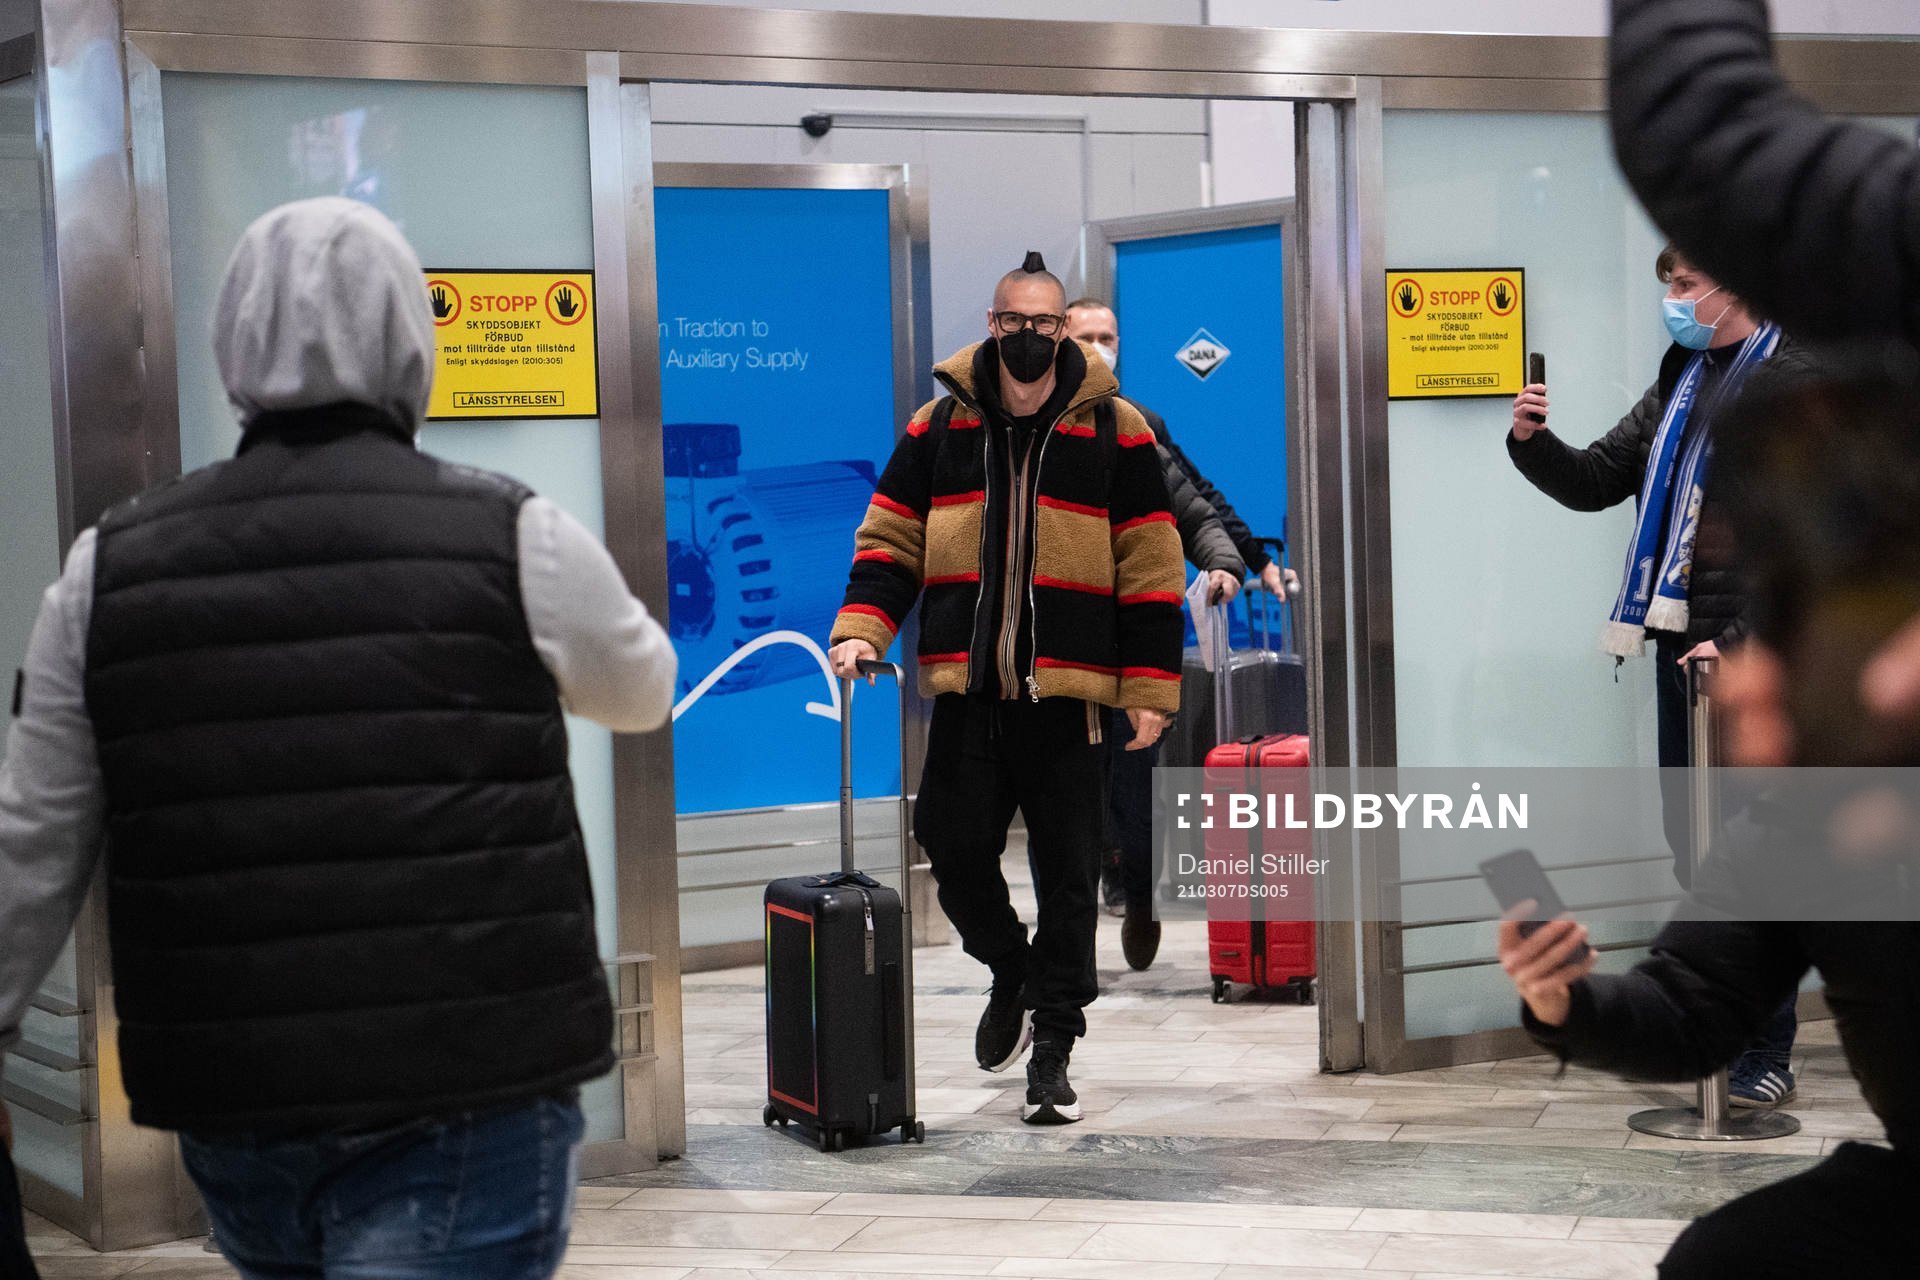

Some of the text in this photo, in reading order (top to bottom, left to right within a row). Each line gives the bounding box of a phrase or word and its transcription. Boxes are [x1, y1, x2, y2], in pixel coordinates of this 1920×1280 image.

[1430, 291, 1480, 305] STOPP
[470, 296, 537, 312] STOPP
[1426, 312, 1483, 321] SKYDDSOBJEKT
[466, 320, 542, 330] SKYDDSOBJEKT
[674, 317, 746, 338] Traction
[751, 319, 769, 337] to
[1440, 323, 1470, 332] FÖRBUD
[484, 331, 524, 342] FÖRBUD
[1409, 334, 1424, 342] mot
[1426, 333, 1456, 342] tillträde
[1459, 332, 1477, 341] utan
[1478, 331, 1509, 341] tillstånd
[443, 344, 463, 353] mot
[466, 343, 506, 353] tillträde
[510, 344, 532, 353] utan
[536, 342, 576, 353] tillstånd
[1429, 344, 1466, 353] skyddslagen
[665, 346, 809, 373] Auxiliary Supply
[1188, 348, 1217, 361] DANA
[446, 355, 564, 367] Enligt skyddslagen (2010:305)
[1422, 376, 1494, 386] LÄNSSTYRELSEN
[461, 394, 557, 405] LÄNSSTYRELSEN
